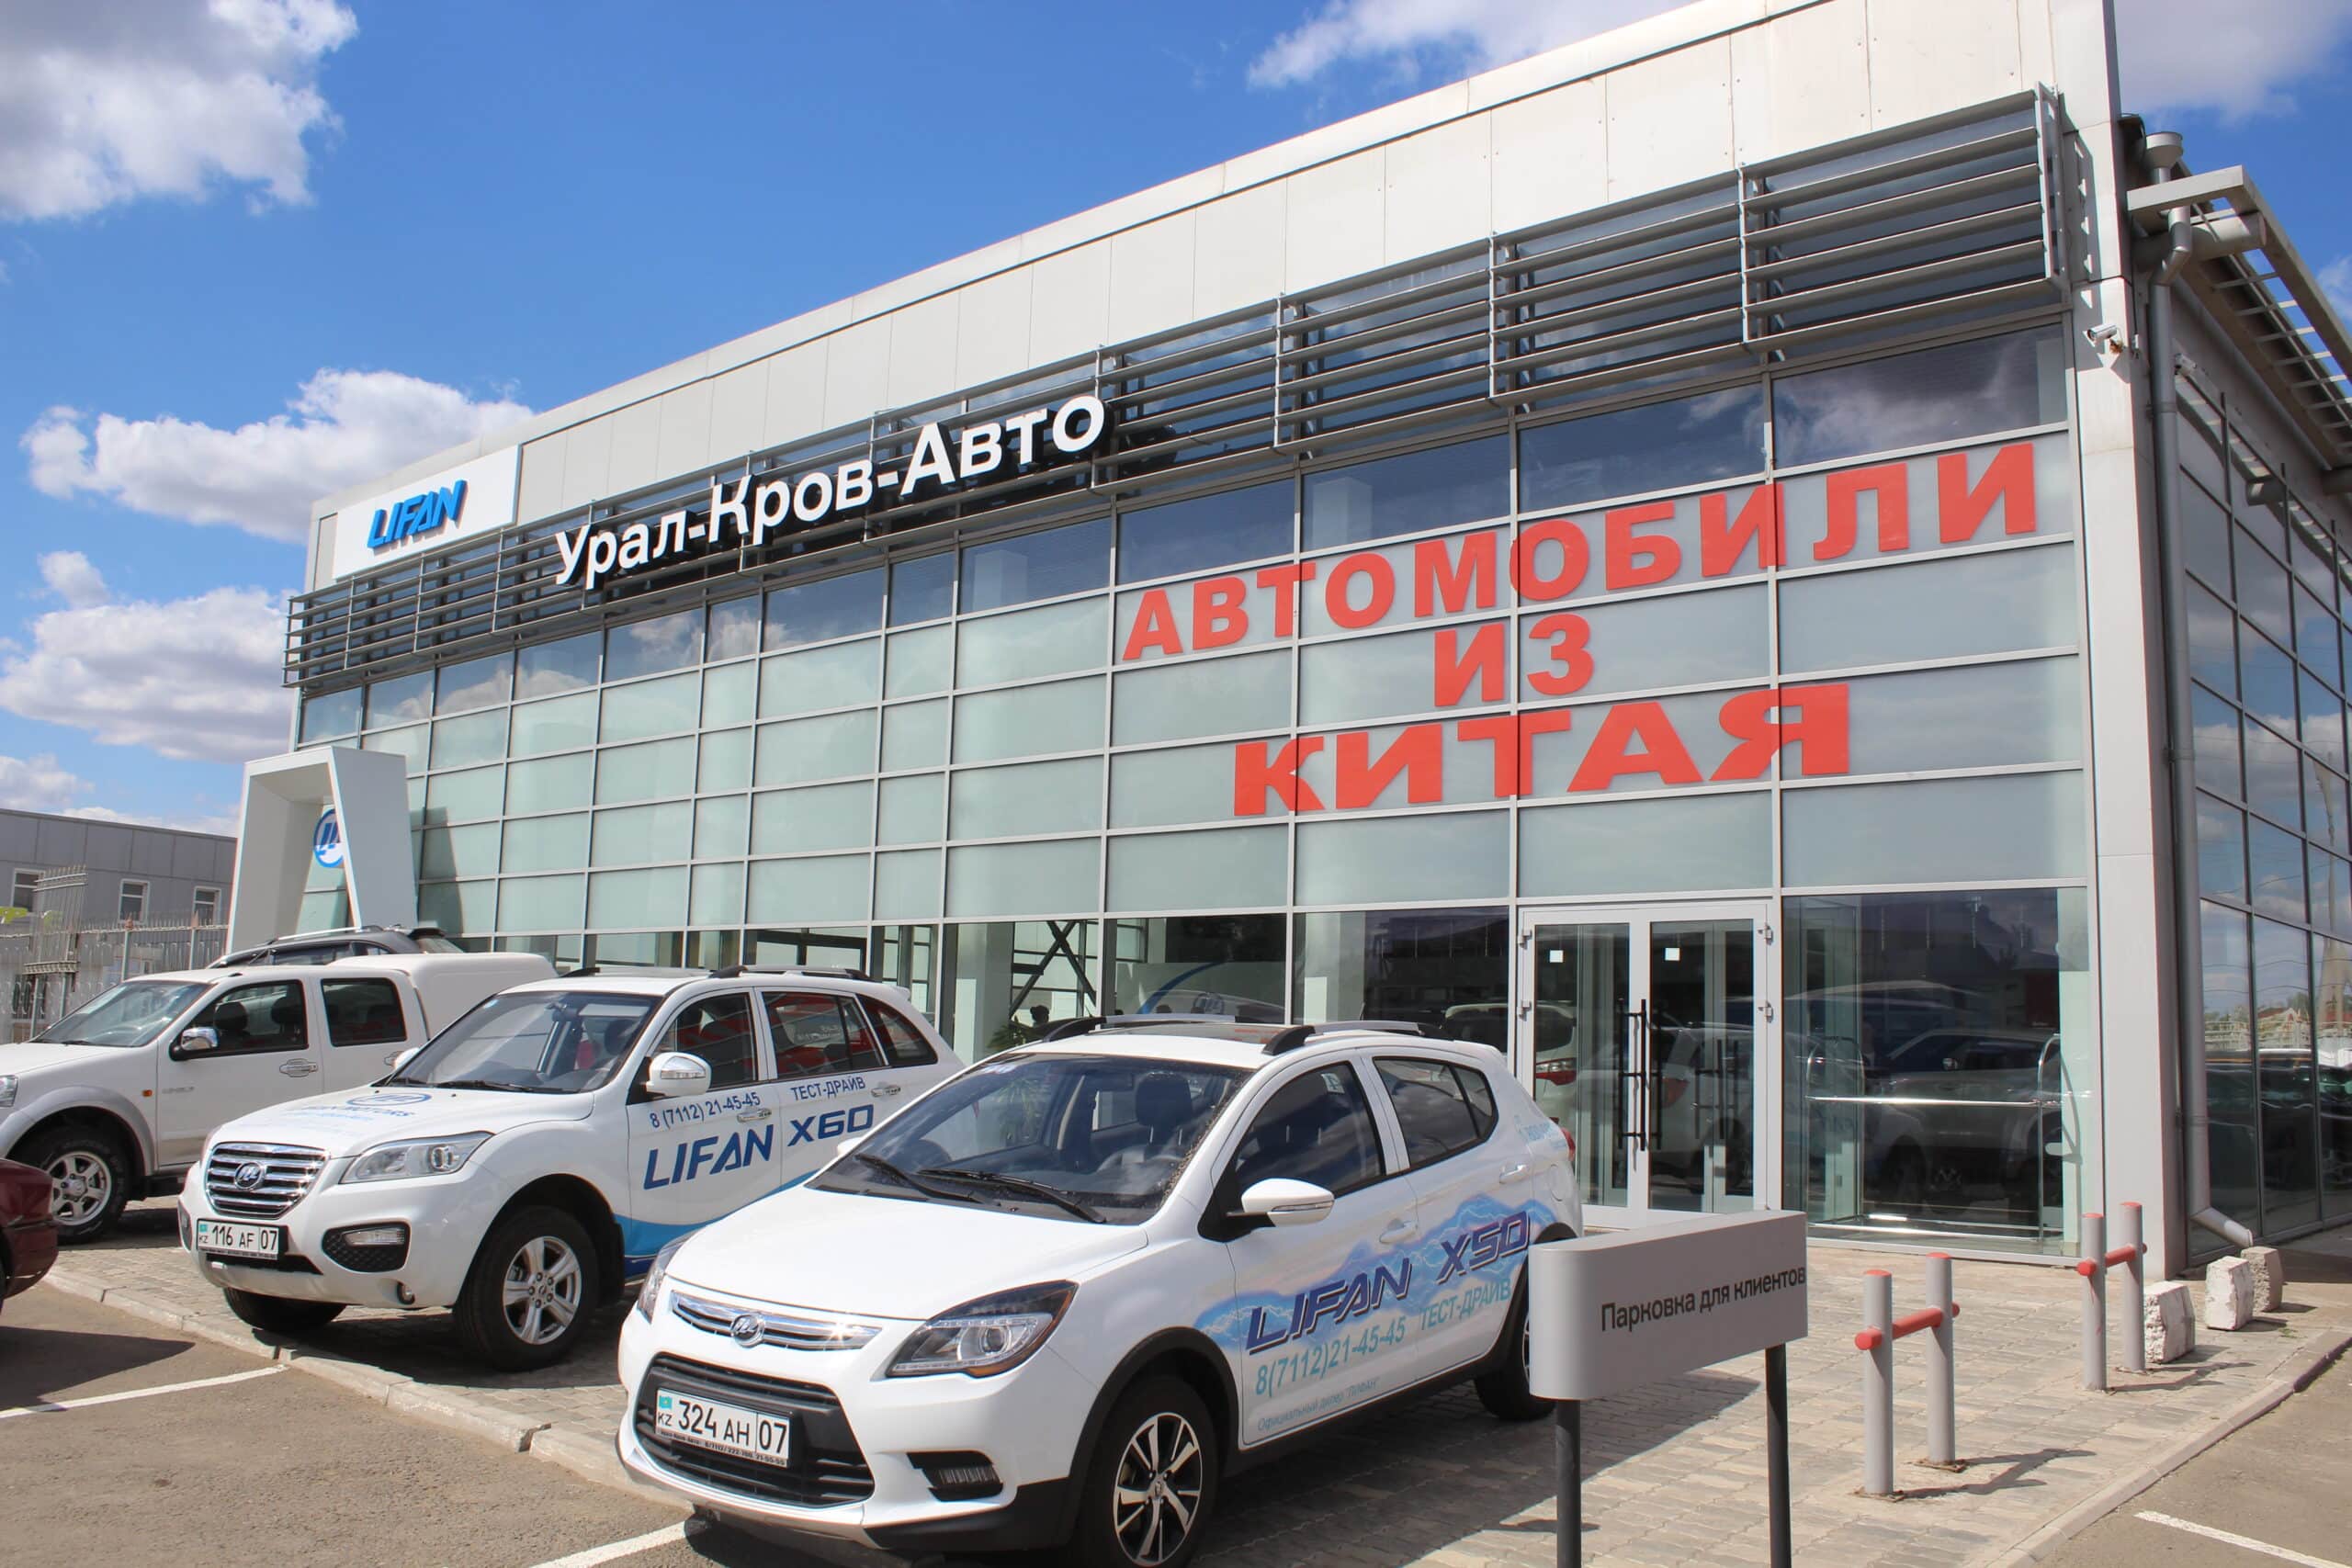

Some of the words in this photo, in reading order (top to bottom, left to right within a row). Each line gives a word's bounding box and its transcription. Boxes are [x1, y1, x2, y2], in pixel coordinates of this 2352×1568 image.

[368, 479, 468, 548] LIFAN
[554, 395, 1105, 591] Урал-Кров-Авто
[1123, 442, 2037, 660] АВТОМОБИЛИ
[1433, 614, 1597, 708] ИЗ
[1233, 683, 1850, 817] КИТАЯ
[649, 1111, 660, 1129] 8
[662, 1102, 705, 1130] (7112)
[707, 1090, 761, 1116] 21-45-45
[790, 1076, 866, 1102] ТЕСТ-ДРАЙВ
[642, 1123, 775, 1190] LIFAN
[786, 1104, 875, 1147] X60
[211, 1224, 233, 1247] 116
[239, 1232, 254, 1248] AF
[260, 1229, 277, 1250] 07
[1246, 1258, 1412, 1356] LIFAN
[1436, 1211, 1531, 1285] X50
[1600, 1291, 1696, 1333] Парковка
[1699, 1284, 1730, 1314] для
[1734, 1265, 1806, 1300] клиентов
[1255, 1314, 1407, 1397] 8(7112)21-45-45
[1419, 1278, 1511, 1332] ТЕСТ-ДРАЙВ
[657, 1412, 673, 1427] KZ
[678, 1399, 718, 1438] 324
[723, 1418, 751, 1447] AH
[759, 1419, 788, 1454] 07
